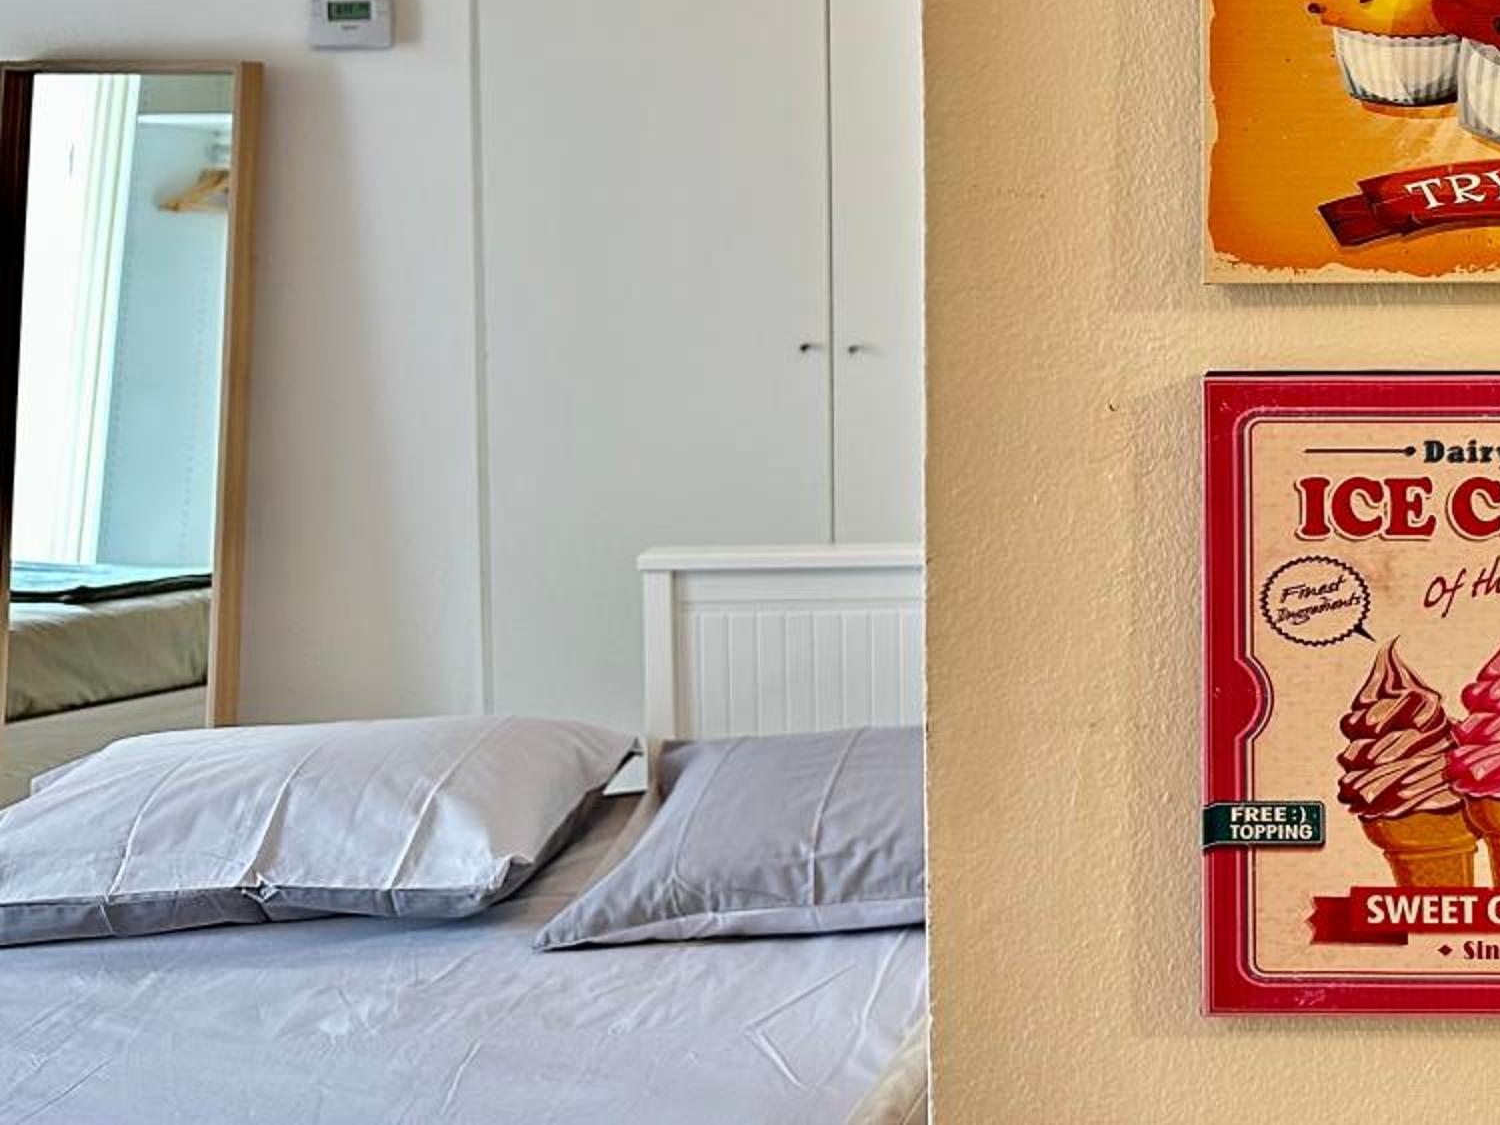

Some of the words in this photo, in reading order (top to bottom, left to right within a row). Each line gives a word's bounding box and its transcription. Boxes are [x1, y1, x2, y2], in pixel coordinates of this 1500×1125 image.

[1296, 476, 1436, 541] ICE
[1280, 574, 1347, 604] Finest
[1424, 568, 1467, 618] Of
[1231, 807, 1287, 822] FREE
[1229, 824, 1313, 840] TOPPING
[1367, 895, 1478, 924] SWEET
